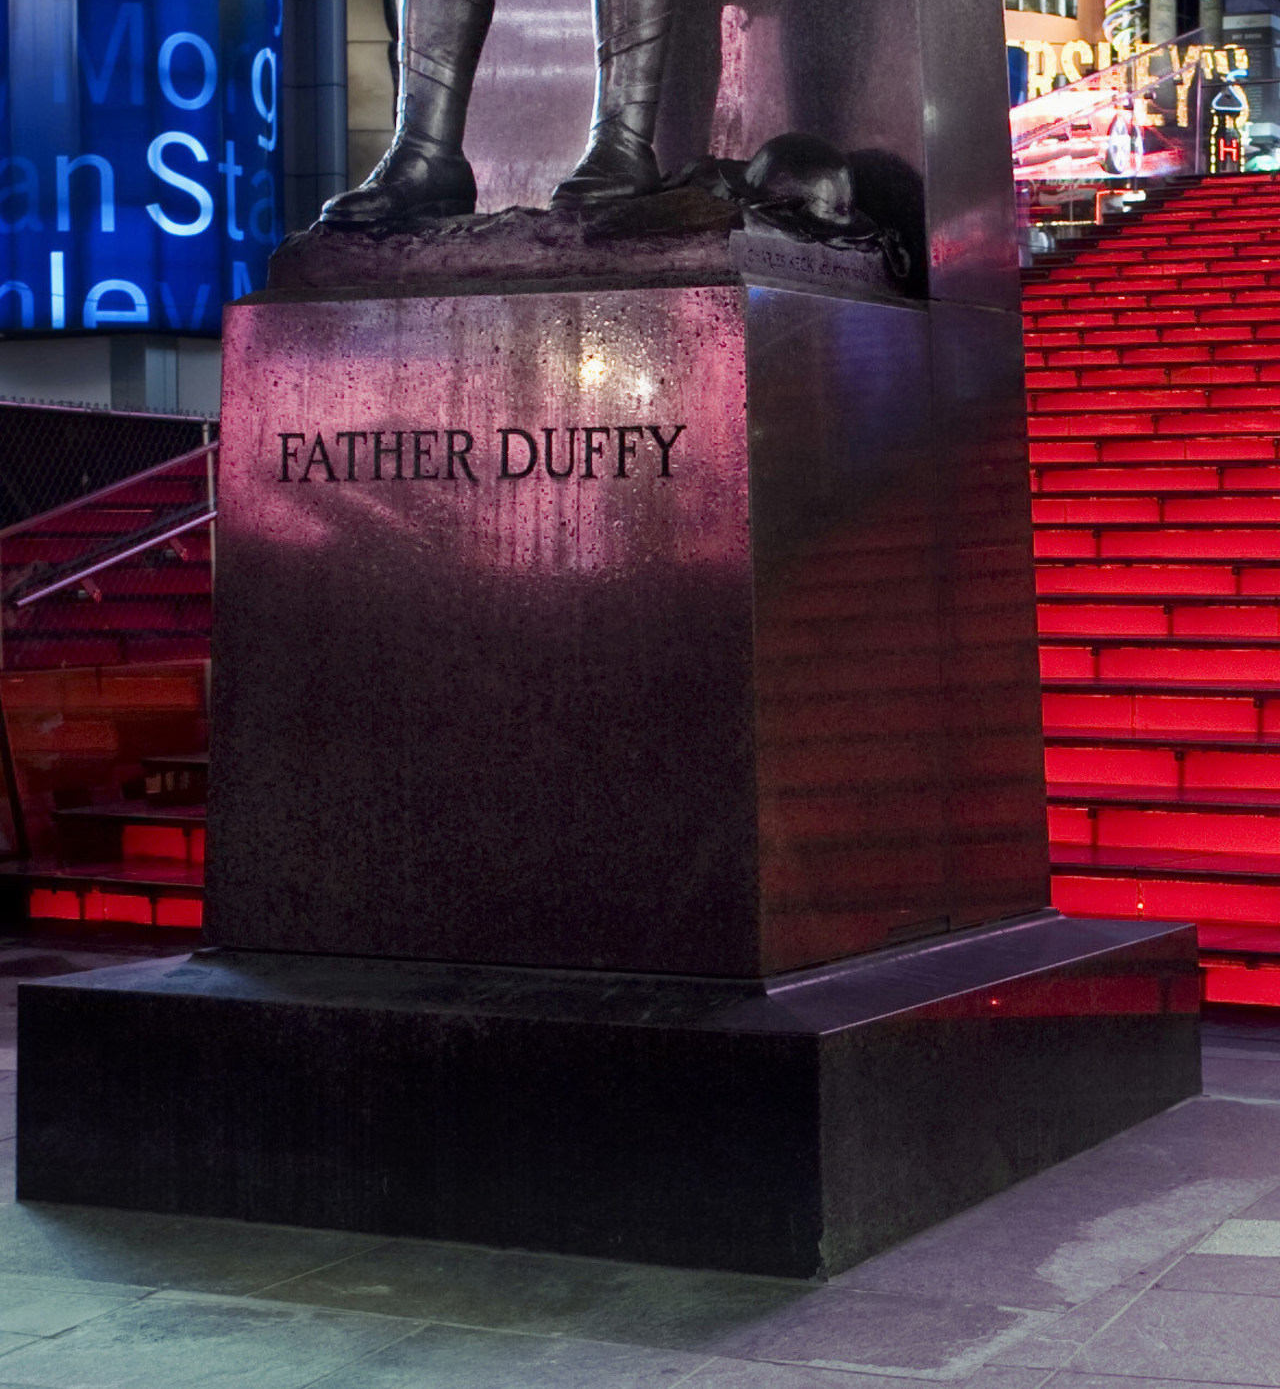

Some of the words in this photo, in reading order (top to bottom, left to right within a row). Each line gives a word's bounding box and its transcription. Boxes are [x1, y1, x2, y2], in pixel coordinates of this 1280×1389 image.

[1219, 138, 1238, 162] H
[277, 429, 479, 484] FATHER
[497, 424, 687, 480] DUFFY
